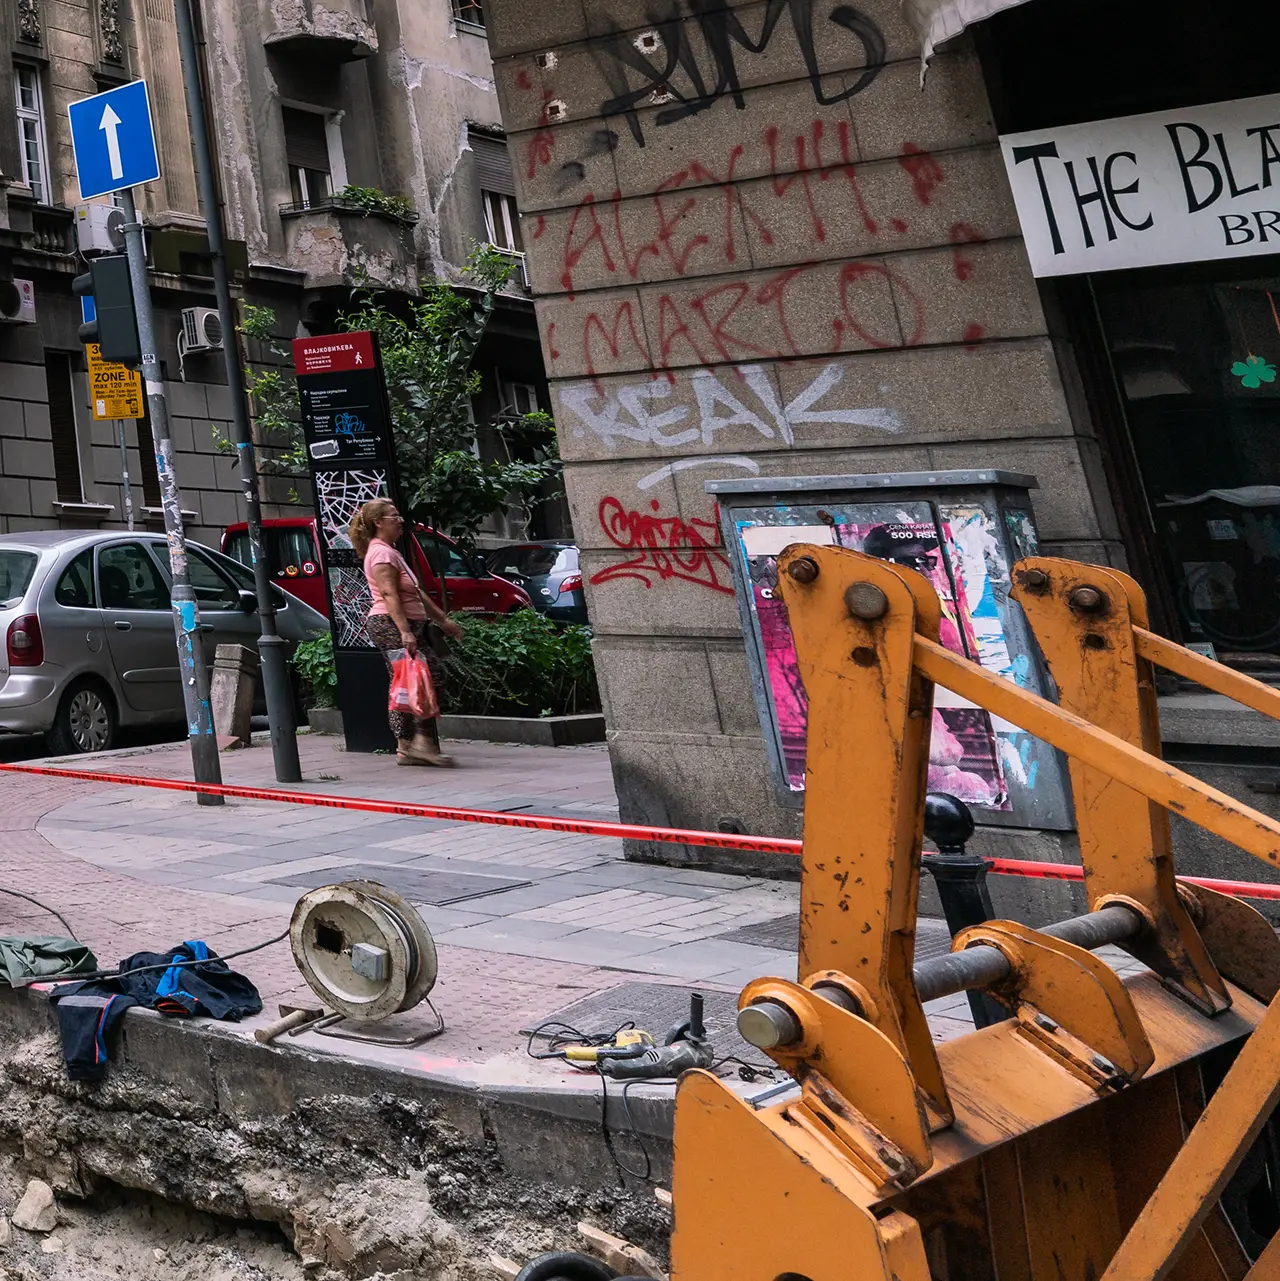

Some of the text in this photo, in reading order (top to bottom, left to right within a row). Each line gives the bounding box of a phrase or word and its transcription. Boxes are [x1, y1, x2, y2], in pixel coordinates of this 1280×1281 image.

[94, 371, 135, 382] ZONE II
[891, 531, 913, 539] 500
